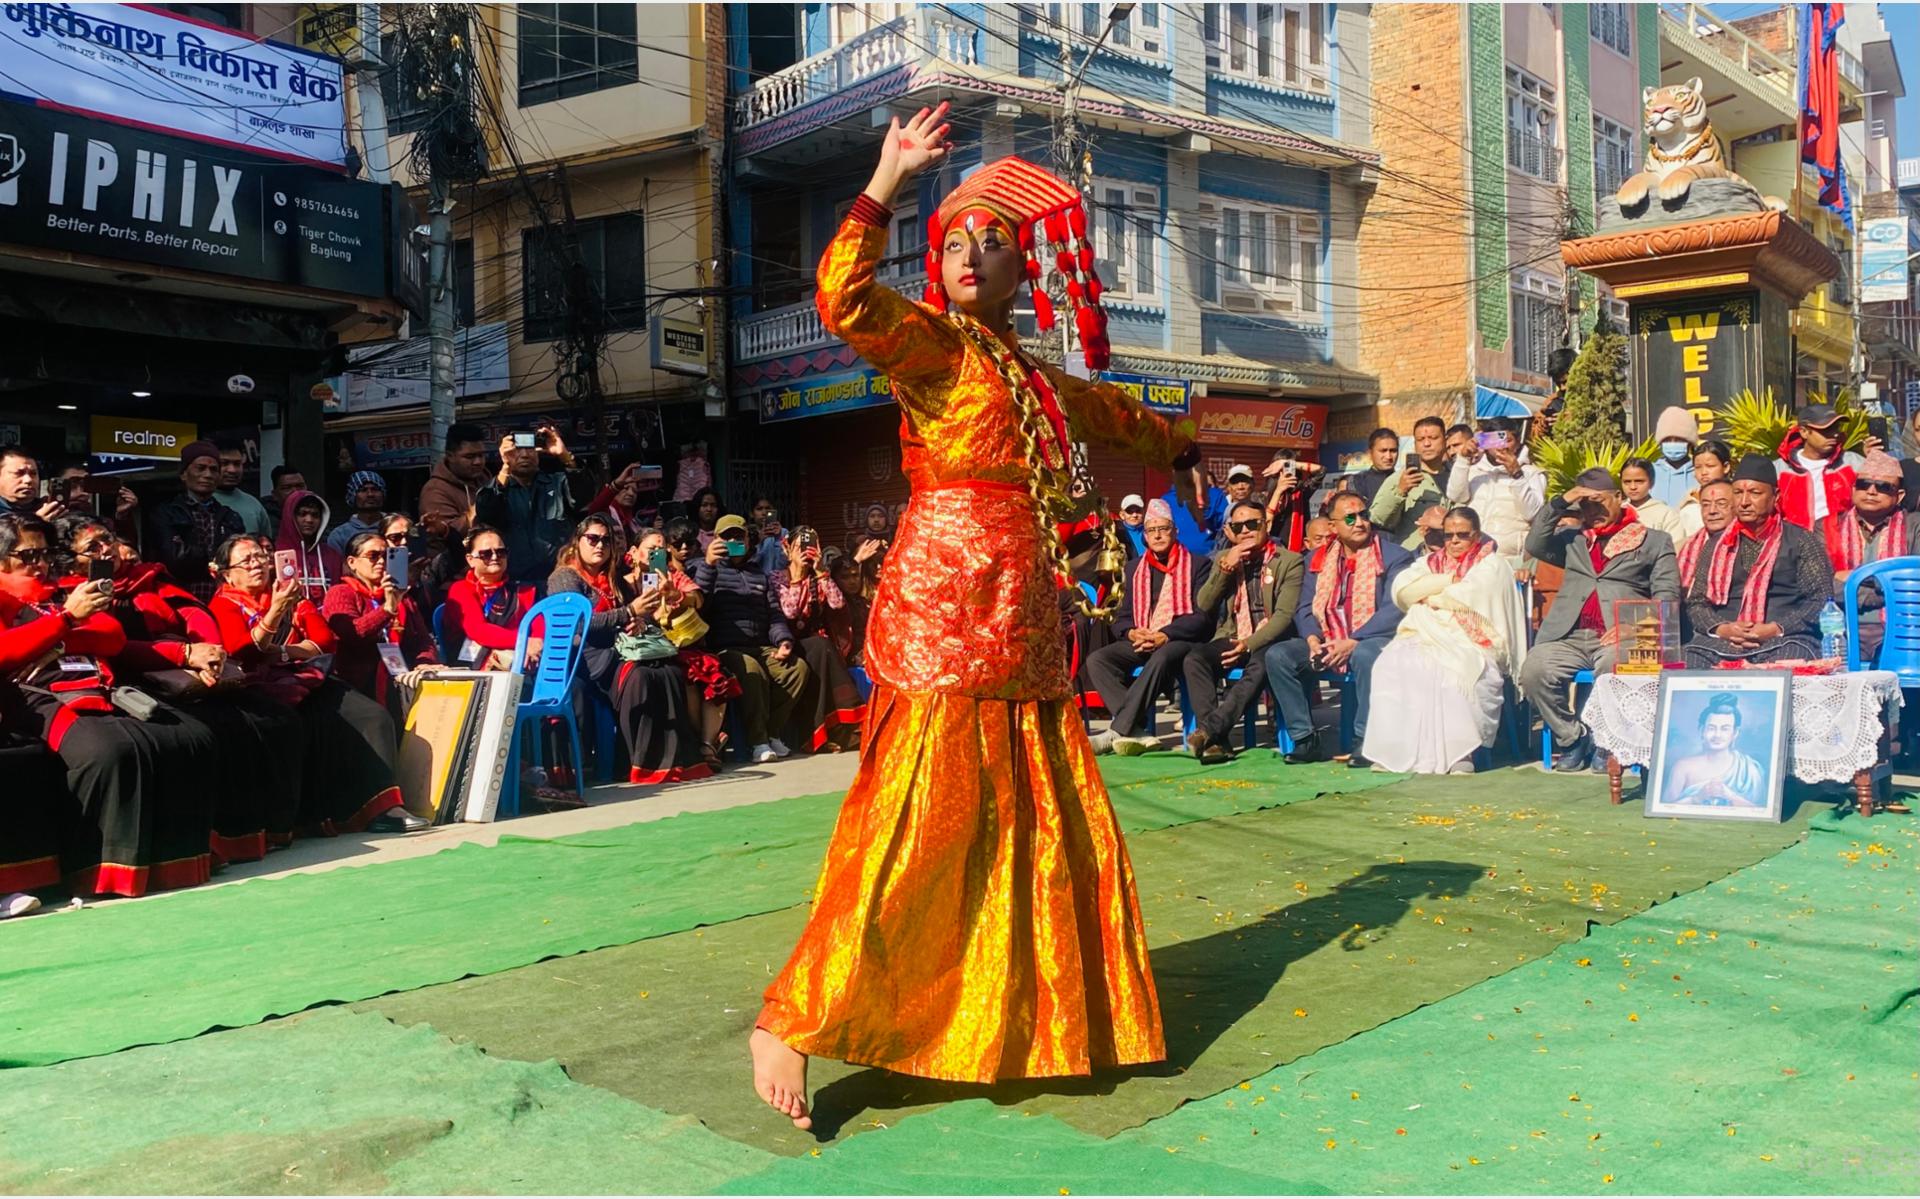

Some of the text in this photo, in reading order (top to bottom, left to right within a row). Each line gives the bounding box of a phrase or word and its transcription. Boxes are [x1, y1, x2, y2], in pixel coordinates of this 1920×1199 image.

[176, 31, 279, 90] विकास
[289, 125, 315, 140] शाखा
[49, 131, 242, 236] IPHIX
[294, 197, 360, 219] 9857634656
[47, 214, 239, 256] Better Parts, Better Repair
[299, 225, 362, 246] Tiger Chowk
[310, 243, 352, 262] Baglung
[1199, 411, 1275, 432] MOBILE
[1273, 419, 1315, 440] HUB
[114, 430, 177, 447] realme
